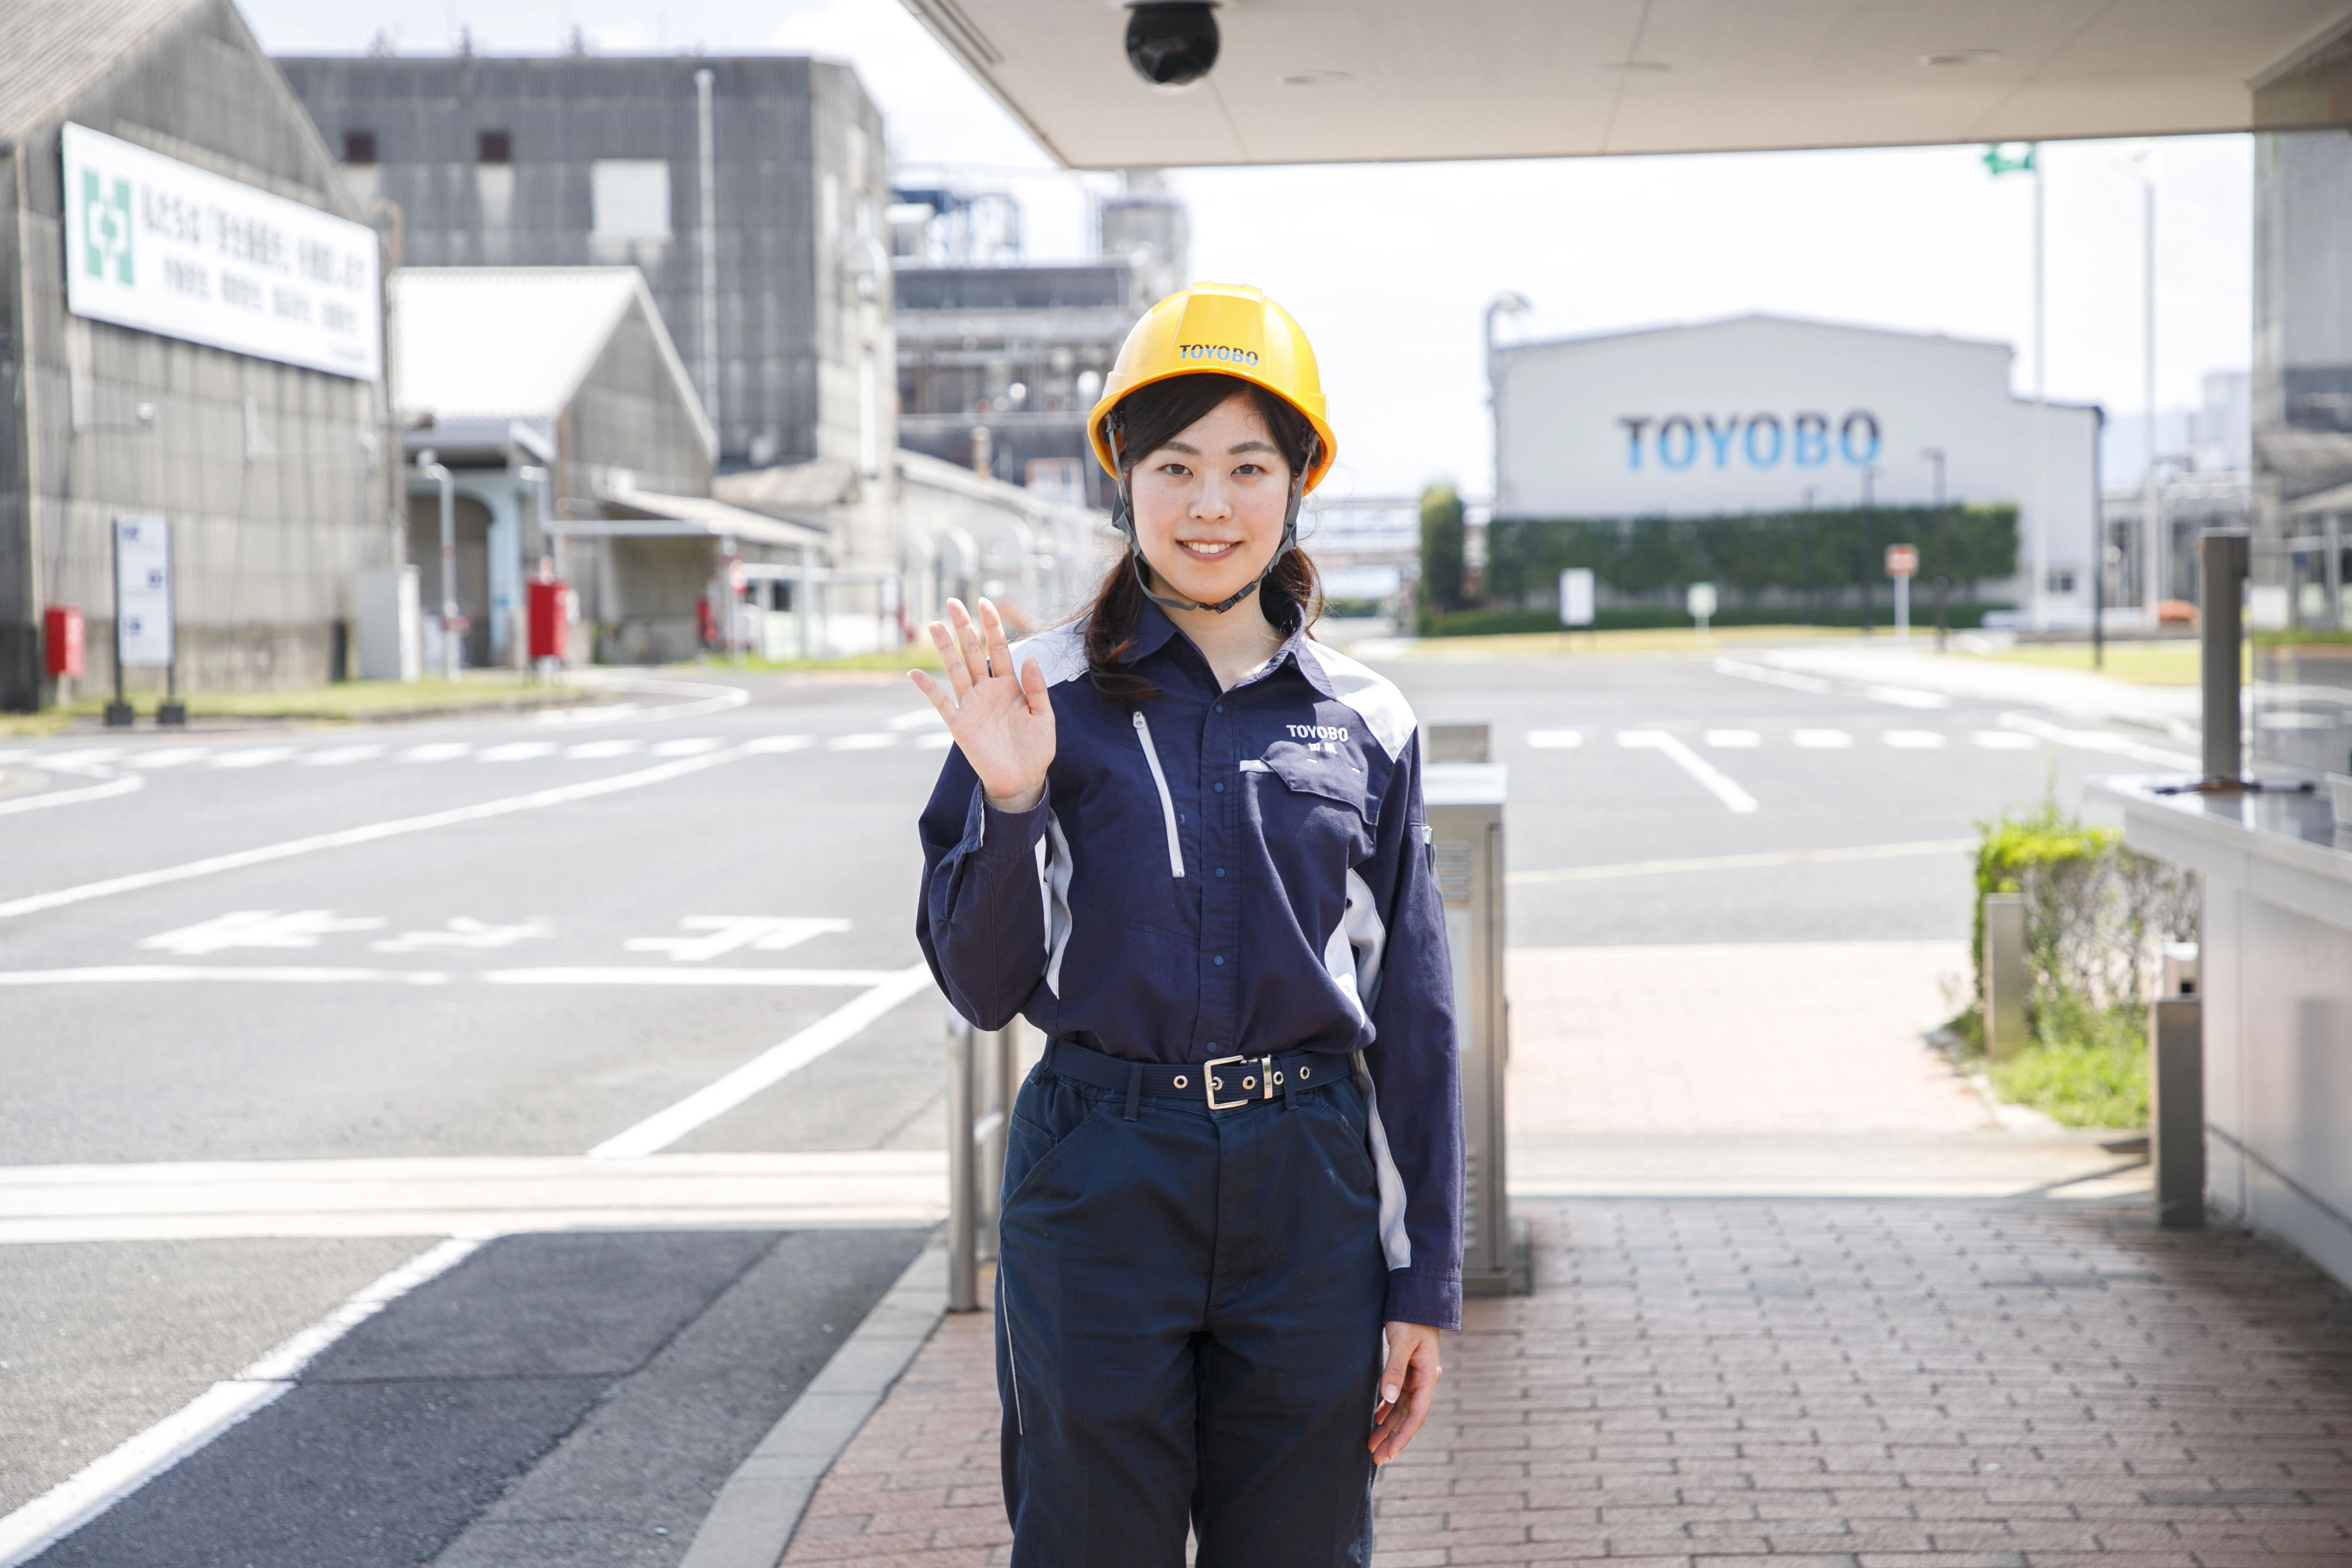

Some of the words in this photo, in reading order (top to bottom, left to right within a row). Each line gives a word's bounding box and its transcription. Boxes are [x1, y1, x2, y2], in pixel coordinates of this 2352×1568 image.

[1180, 344, 1258, 366] TOYOBO
[1618, 408, 1882, 470] TOYOBO
[1286, 725, 1348, 742] TOYOBO
